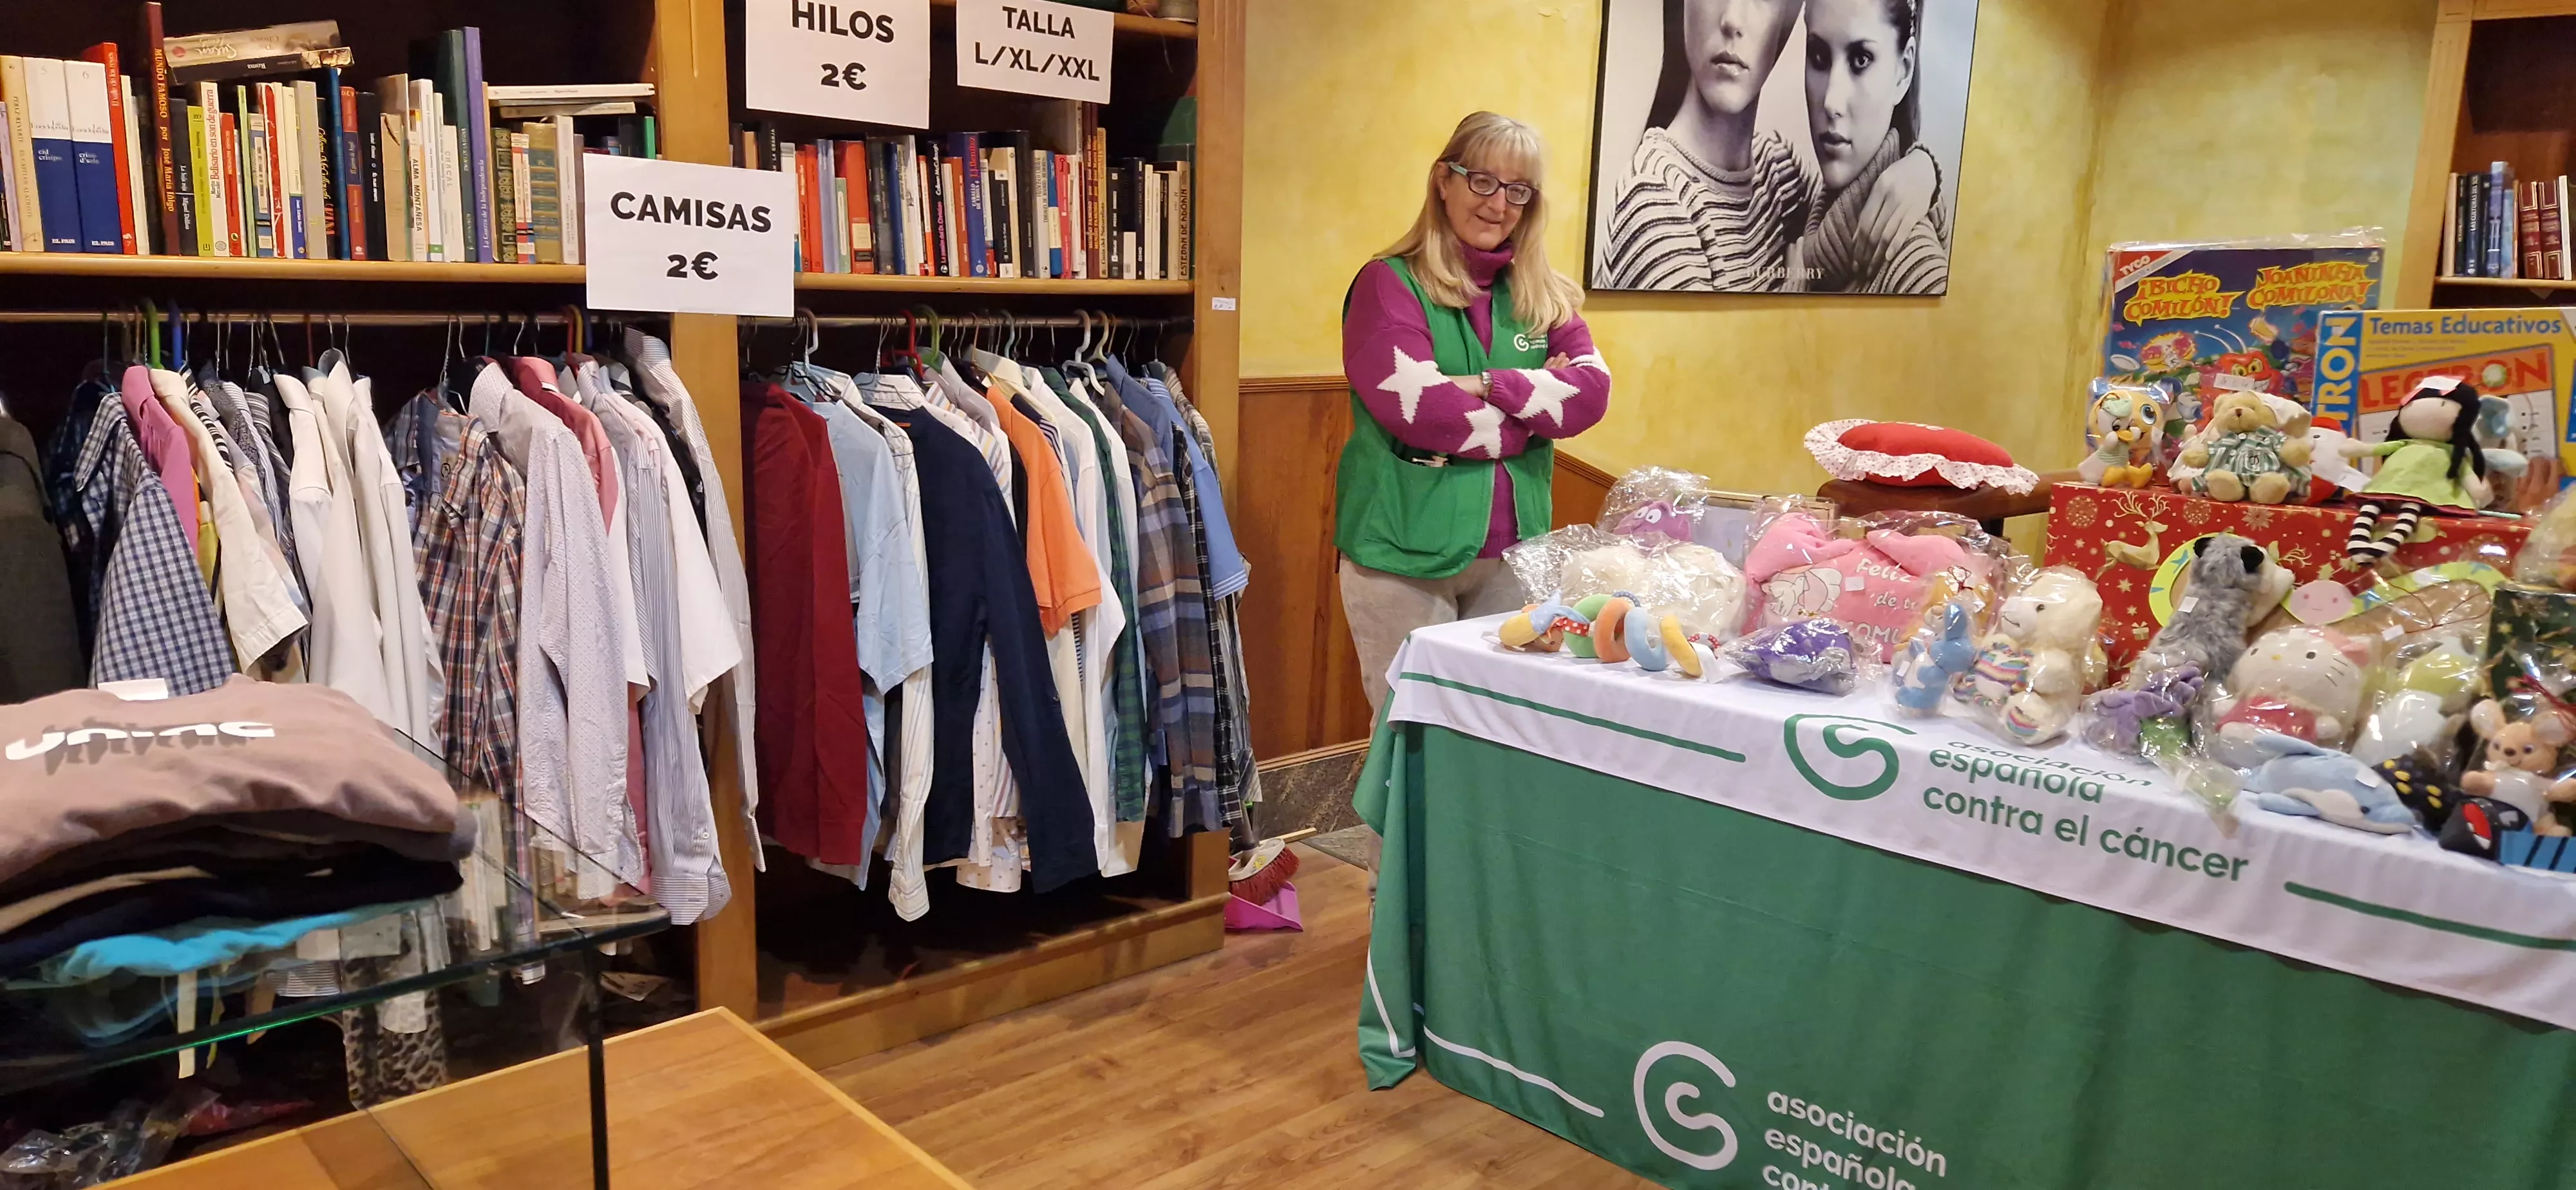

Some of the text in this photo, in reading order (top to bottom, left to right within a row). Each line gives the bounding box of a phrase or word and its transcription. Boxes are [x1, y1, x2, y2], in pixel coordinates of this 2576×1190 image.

[792, 0, 894, 42] HILOS
[1002, 6, 1075, 39] TALLA
[41, 66, 47, 74] 5
[155, 48, 166, 80] MUNDO
[820, 62, 866, 90] 2€
[975, 42, 1100, 82] L/XL/XXL
[157, 83, 167, 118] FAMOSO
[207, 90, 217, 113] guerra
[160, 126, 169, 141] por
[207, 115, 215, 124] de
[162, 147, 171, 165] José
[211, 138, 216, 147] en
[210, 149, 220, 180] Belisario
[478, 160, 488, 203] Independencia
[413, 185, 422, 232] MONTAÑESA
[611, 191, 772, 233] CAMISAS
[1180, 225, 1188, 235] DE
[667, 251, 719, 280] 2€
[1747, 267, 1825, 279] BURBERRY
[2257, 263, 2364, 288] JOANINHA
[2249, 281, 2369, 307] COMILONA!
[2370, 312, 2561, 335] Temas Educativos
[2316, 316, 2358, 420] TRON
[1877, 591, 1897, 607] de
[1929, 748, 2105, 804] española
[1948, 740, 2153, 788] asociación
[1923, 786, 2249, 882] contra el cáncer
[1766, 1091, 1946, 1177] asociación
